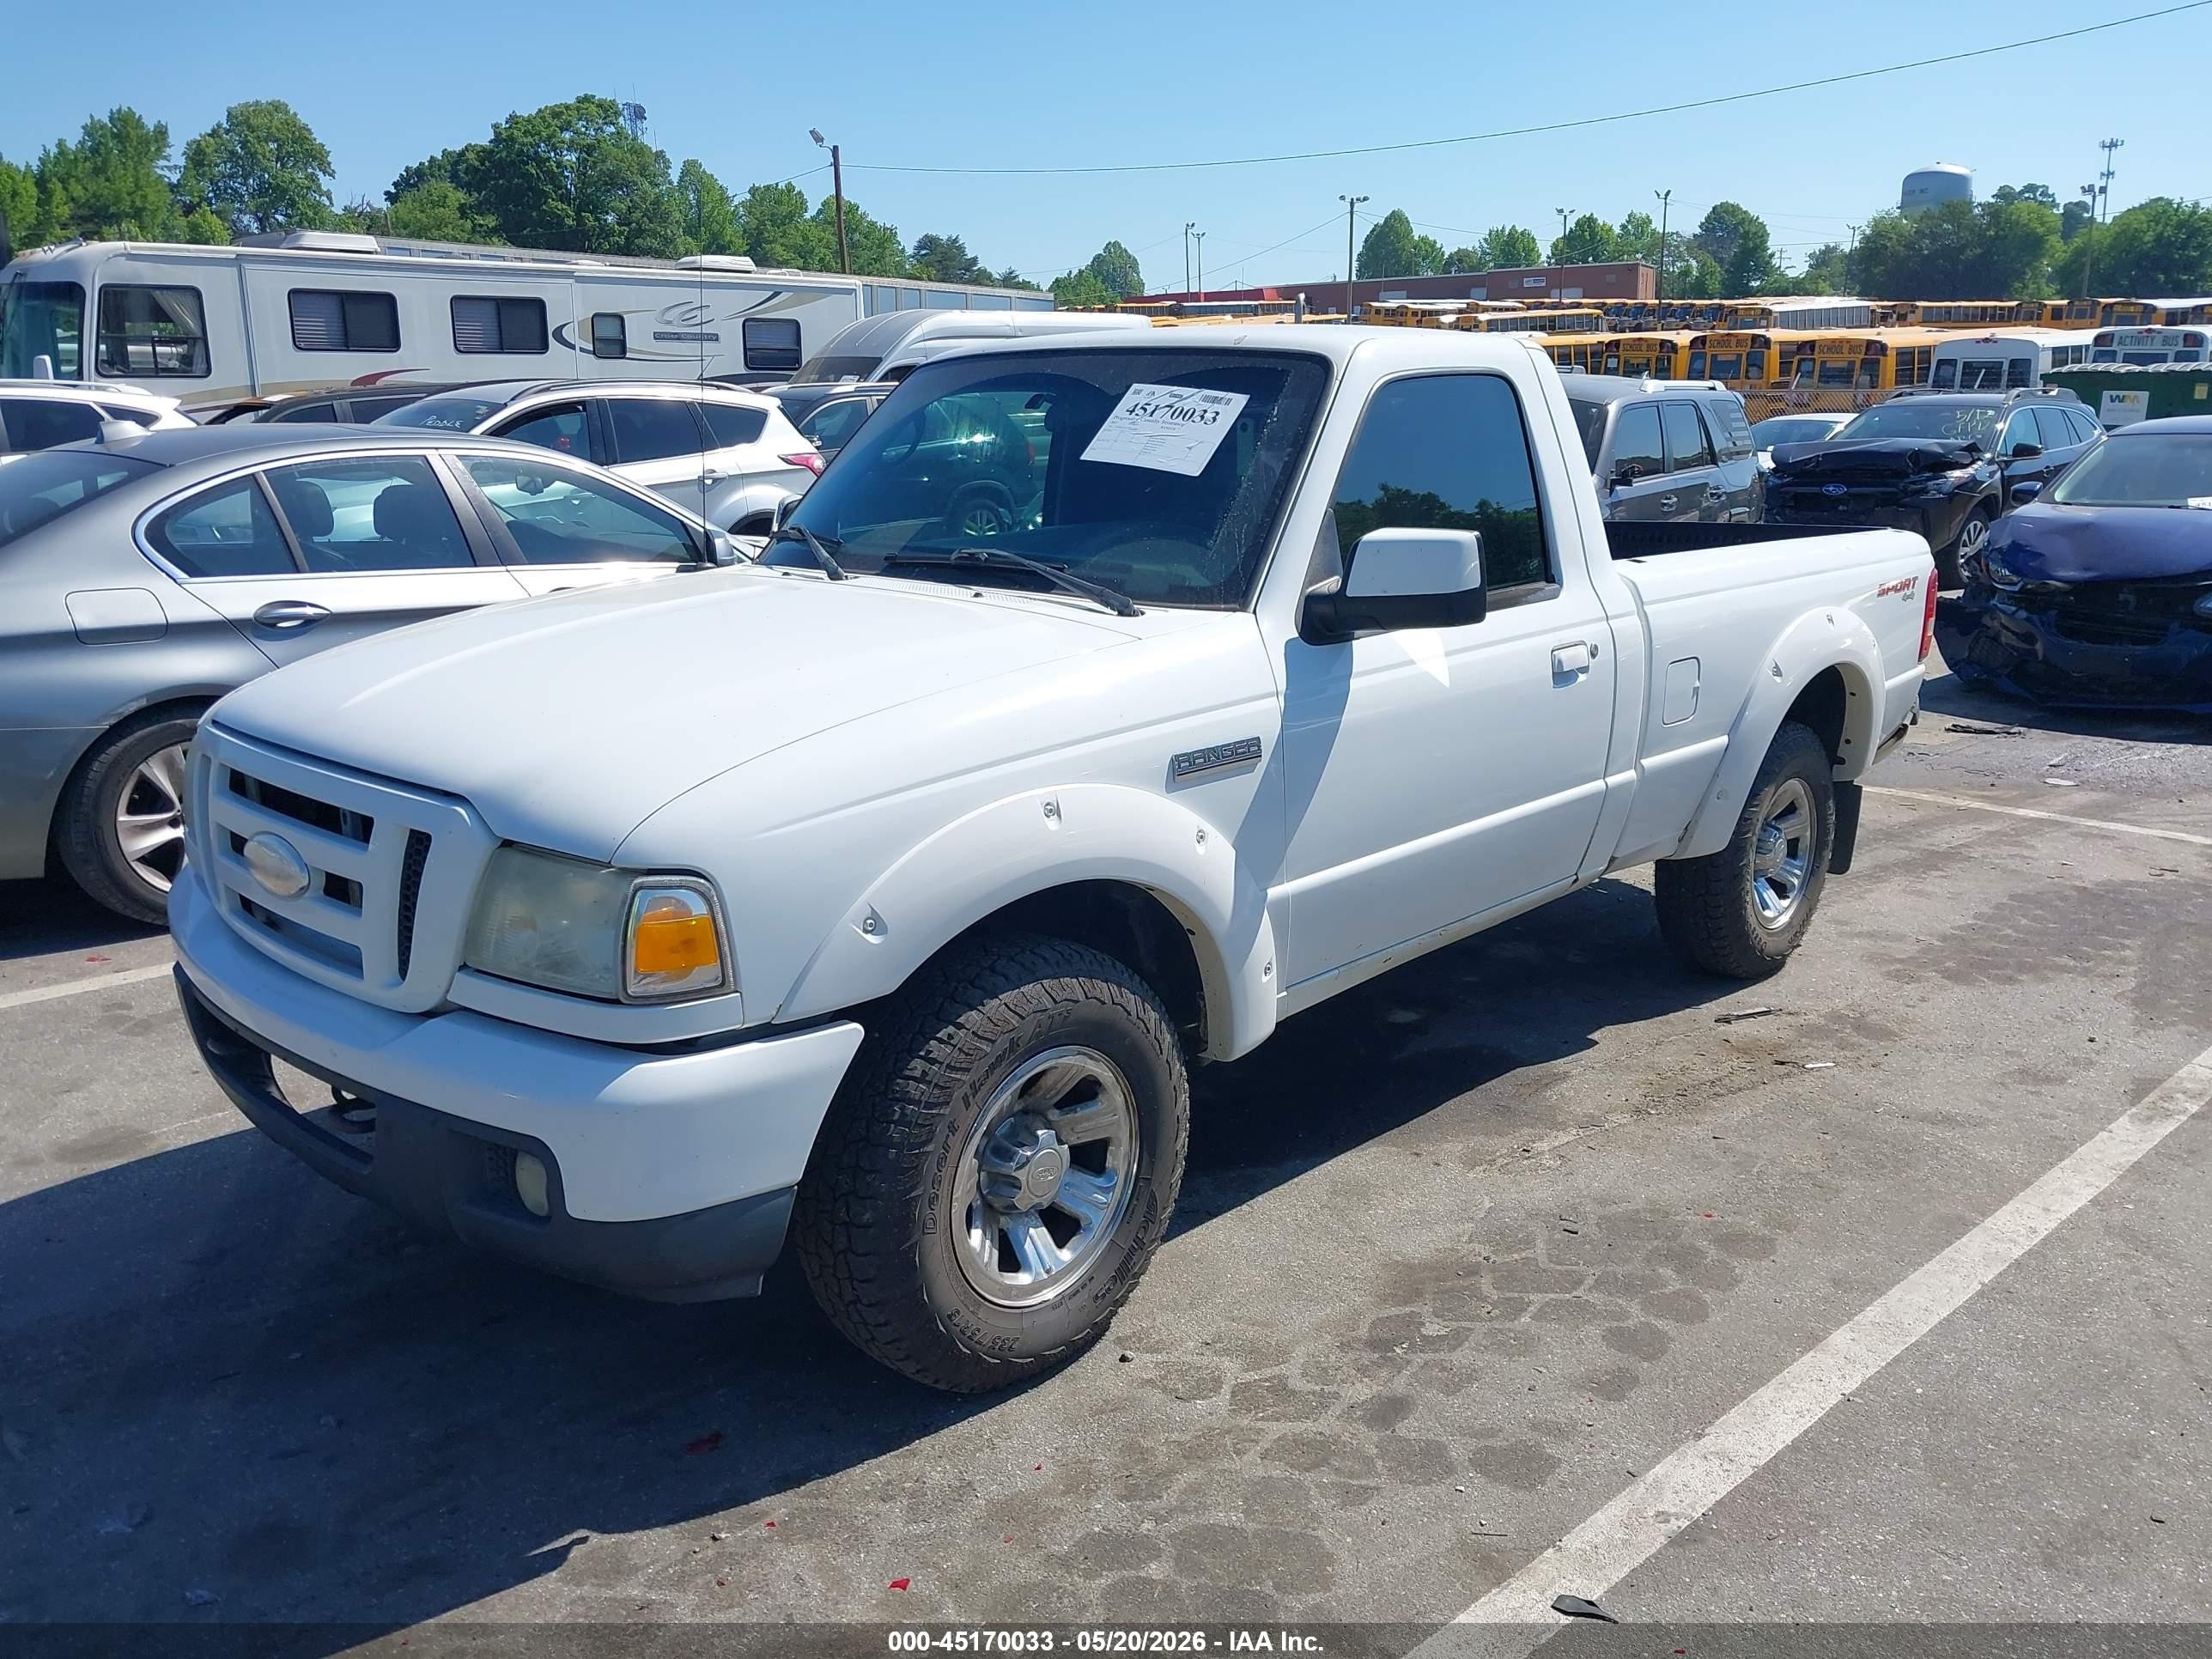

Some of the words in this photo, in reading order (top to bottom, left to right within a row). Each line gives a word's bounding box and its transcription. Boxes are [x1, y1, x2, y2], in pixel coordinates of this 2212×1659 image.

[1621, 343, 1644, 352] SCHOOL
[1646, 343, 1657, 352] BUS
[1707, 338, 1732, 349] SCHOOL
[1735, 337, 1748, 348] BUS
[1818, 344, 1844, 355] SCHOOL
[1847, 344, 1863, 355] BUS
[2117, 335, 2156, 347] ACTIVITY
[2161, 335, 2179, 347] BUS
[1126, 401, 1220, 426] 45170033
[1876, 575, 1919, 599] SPORT
[1176, 739, 1261, 771] RANGER
[922, 1118, 960, 1235] Desert
[962, 1035, 1024, 1112] Hawk
